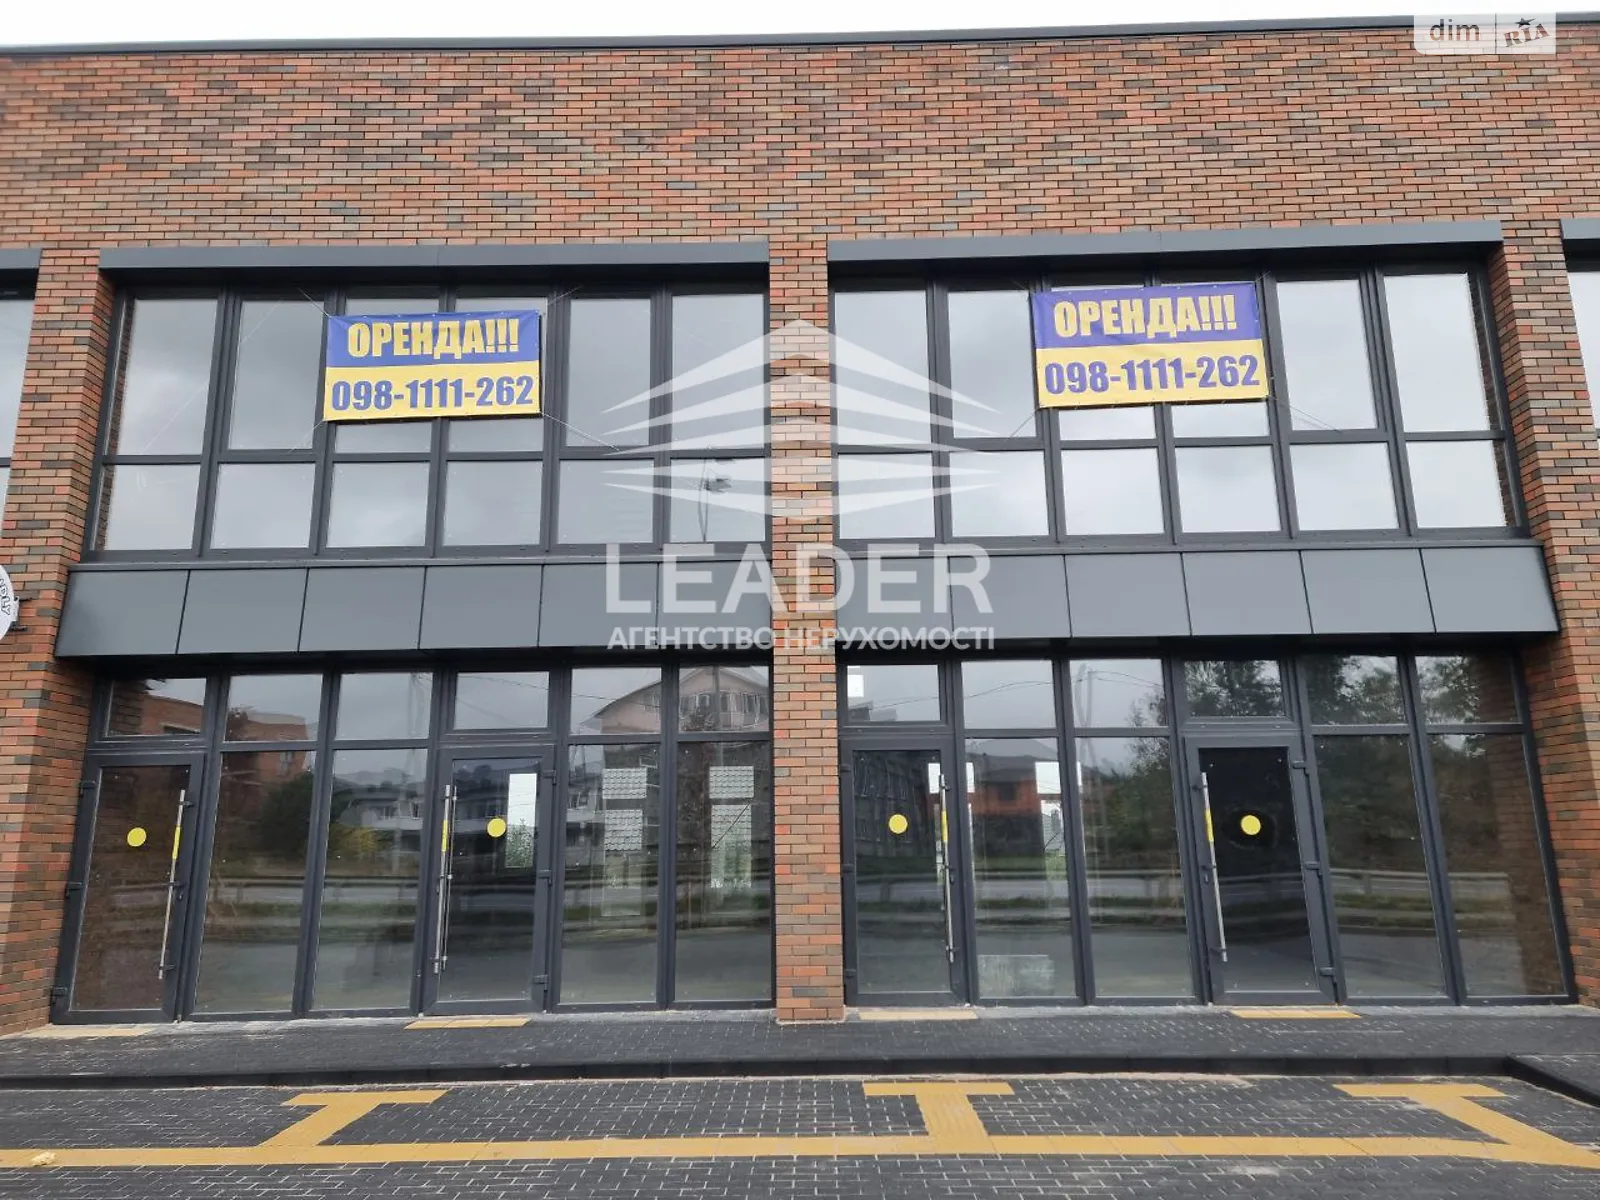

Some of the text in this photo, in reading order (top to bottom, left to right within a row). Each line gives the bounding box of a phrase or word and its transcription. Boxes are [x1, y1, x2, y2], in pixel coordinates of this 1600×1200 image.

[1054, 294, 1237, 339] ОРЕНДА!!!
[348, 318, 519, 360] ОРЕНДА!!!
[331, 376, 533, 411] 098-1111-262
[1044, 354, 1260, 394] 098-1111-262
